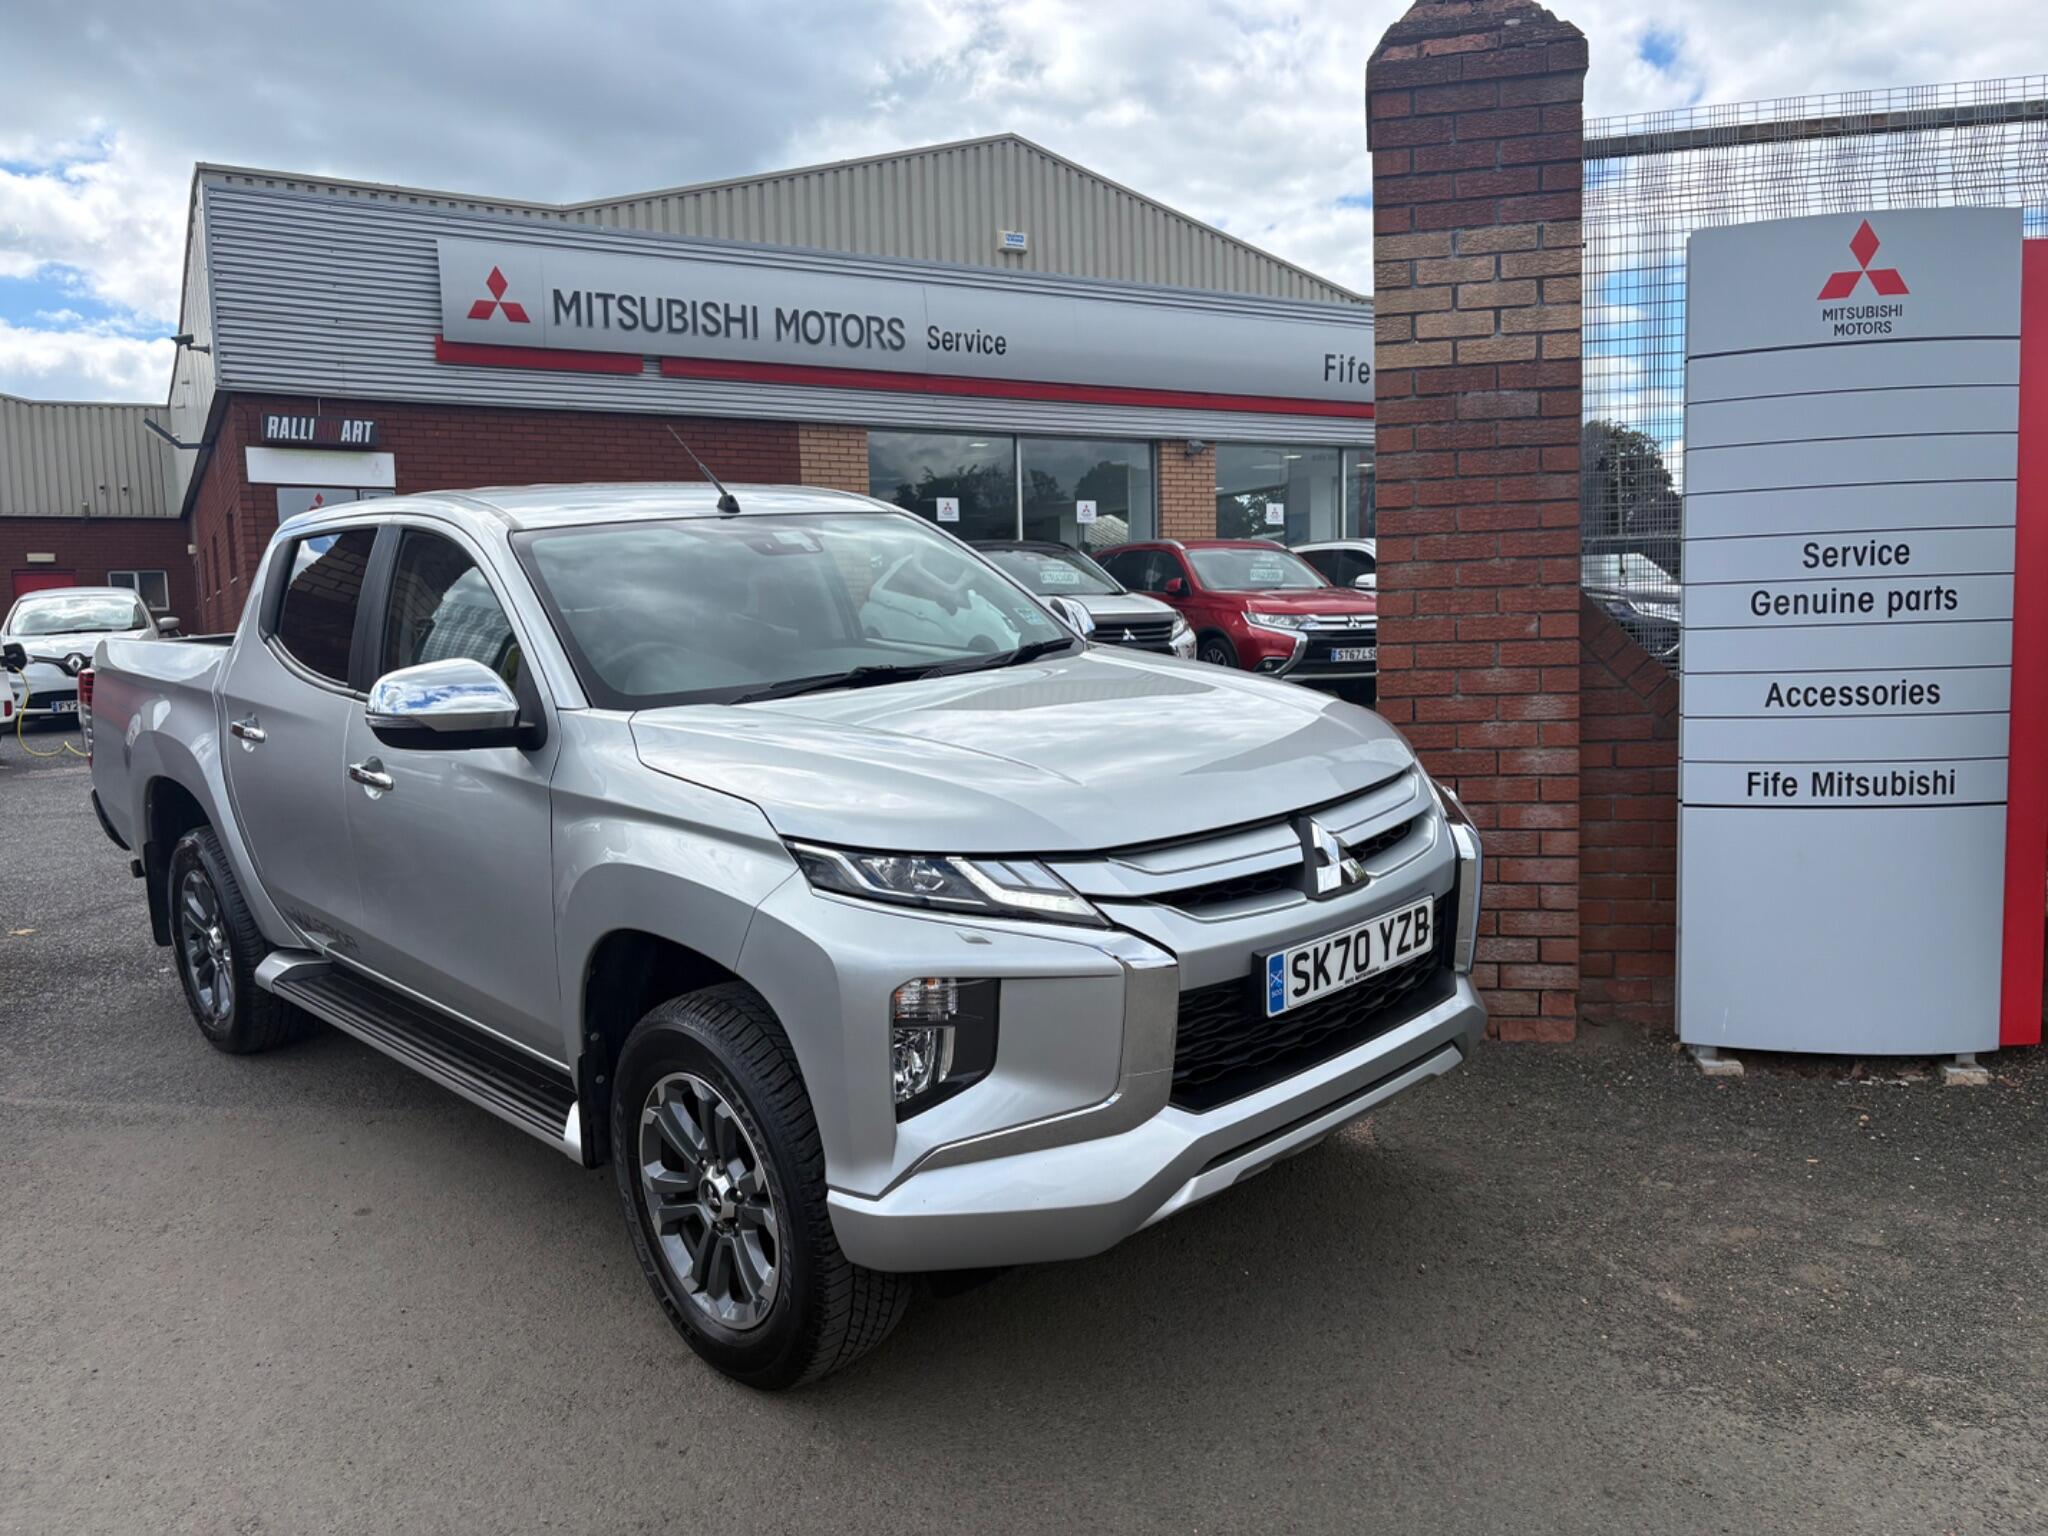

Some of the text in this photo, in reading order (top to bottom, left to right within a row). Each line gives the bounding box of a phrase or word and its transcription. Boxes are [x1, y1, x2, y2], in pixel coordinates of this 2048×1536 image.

[552, 289, 1008, 356] MITSUBISHI MOTORS Service
[1822, 304, 1903, 336] MITSUBISHI MOTORS
[1324, 353, 1371, 384] Fife
[267, 416, 374, 443] RALLI ART
[1803, 539, 1911, 569] Service
[1751, 586, 1958, 619] Genuine parts
[1765, 679, 1941, 708] Accessories
[1747, 768, 1956, 798] Fife Mitsubishi
[1292, 905, 1430, 997] SK70 YZB
